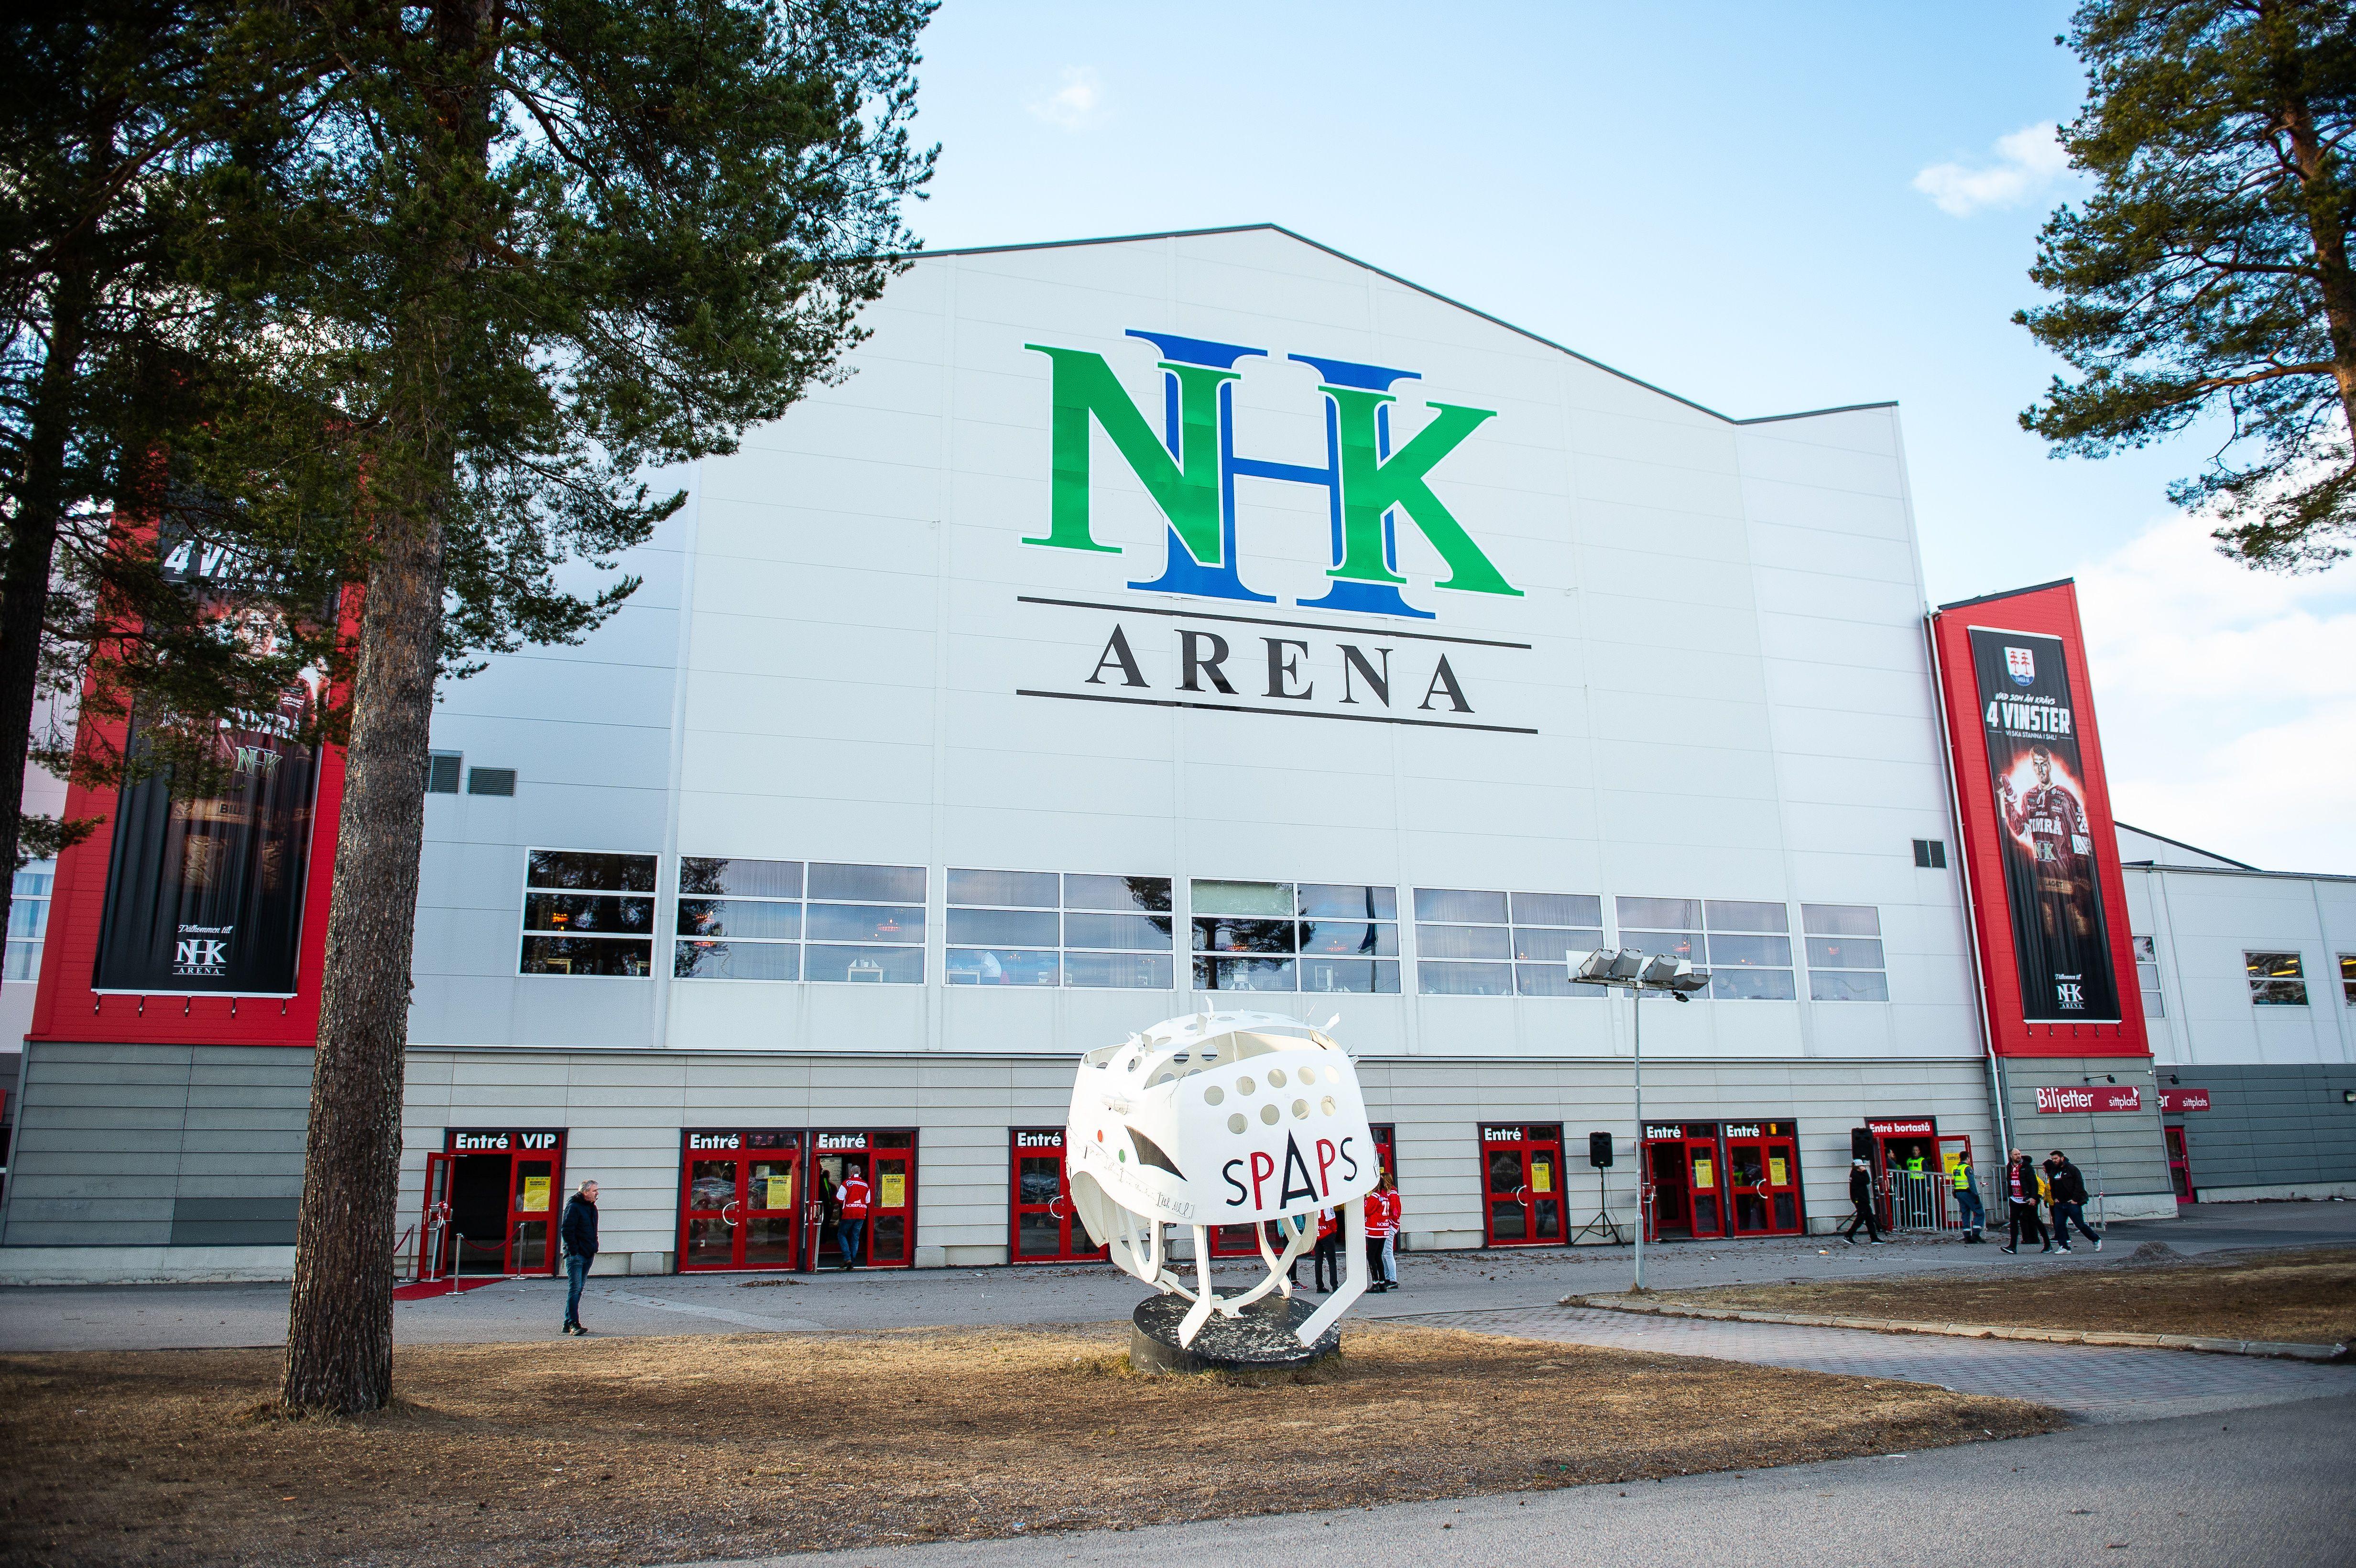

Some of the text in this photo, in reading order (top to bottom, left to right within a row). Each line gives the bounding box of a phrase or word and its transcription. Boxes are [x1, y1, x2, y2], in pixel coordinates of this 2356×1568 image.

[1021, 328, 1525, 620] NHK
[1084, 623, 1475, 714] ARENA
[1986, 701, 2071, 734] 4 VINSTER
[174, 939, 227, 965] NHK
[2056, 984, 2083, 1002] NHK
[2036, 1087, 2094, 1113] Biljetter
[2109, 1095, 2138, 1109] sittplats
[2182, 1095, 2208, 1109] sittplats
[1484, 1127, 1521, 1141] Entré
[1647, 1125, 1681, 1138] Entré
[1727, 1124, 1760, 1137] Entré
[1869, 1122, 1931, 1133] Entré bortastå
[456, 1133, 555, 1149] Entré VIP
[690, 1133, 739, 1149] Entré
[818, 1133, 866, 1149] Entré
[1017, 1132, 1061, 1146] Entré
[1222, 1129, 1357, 1211] SPAPS
